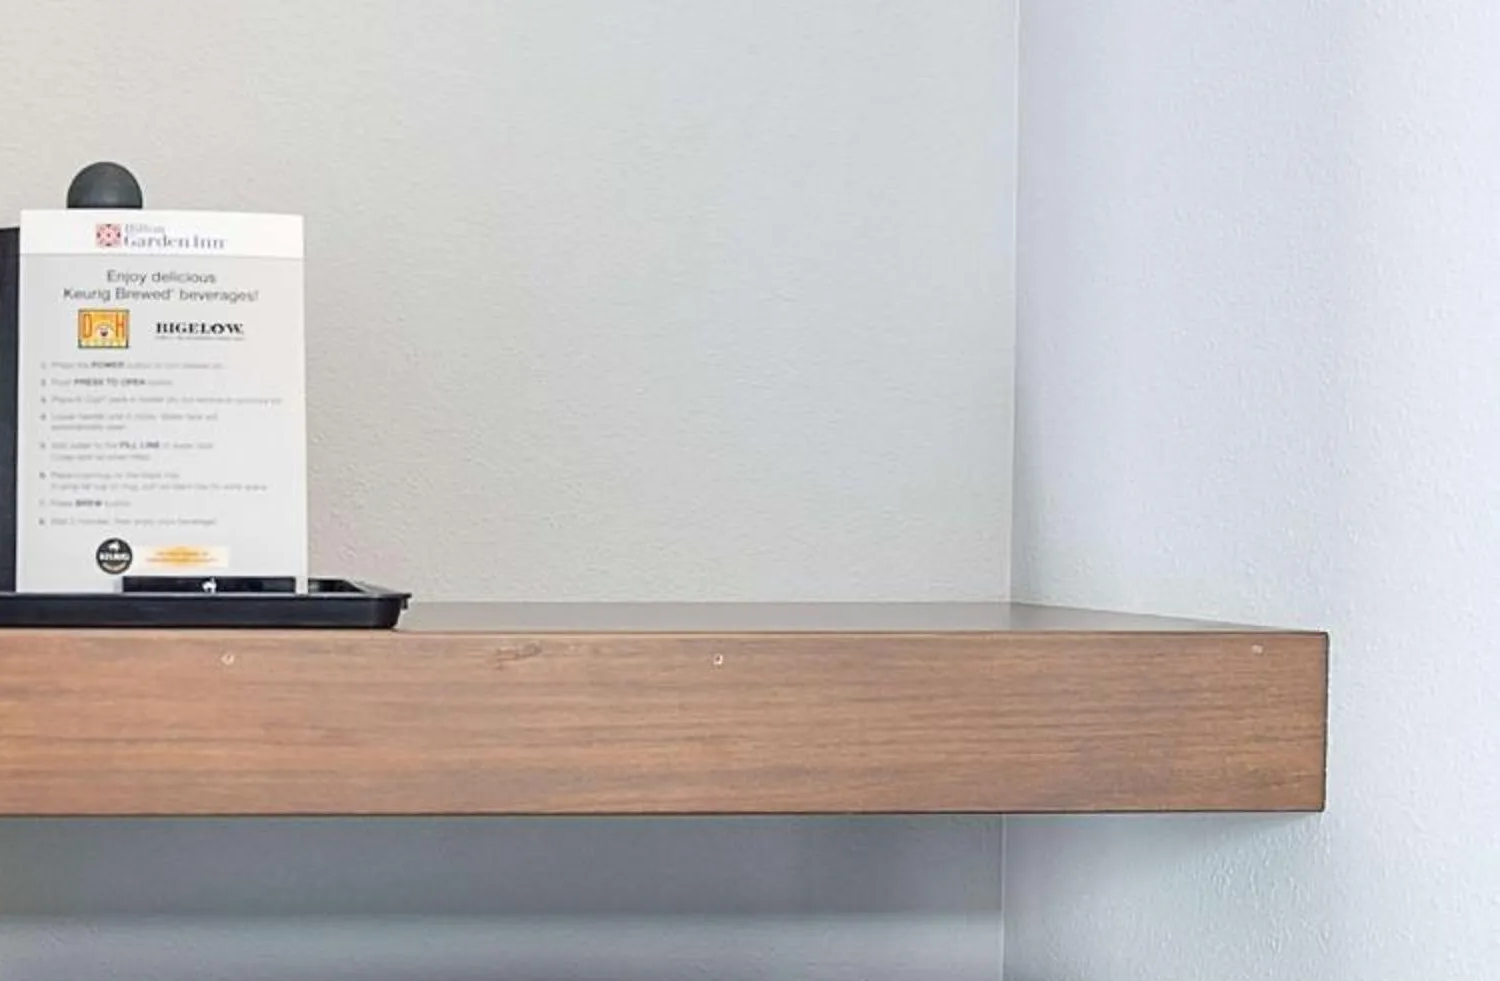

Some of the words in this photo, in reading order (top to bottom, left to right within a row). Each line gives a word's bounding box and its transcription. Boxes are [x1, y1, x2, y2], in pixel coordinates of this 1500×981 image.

[106, 269, 147, 286] Enjoy
[151, 270, 217, 283] delicious
[63, 287, 111, 303] Keurig
